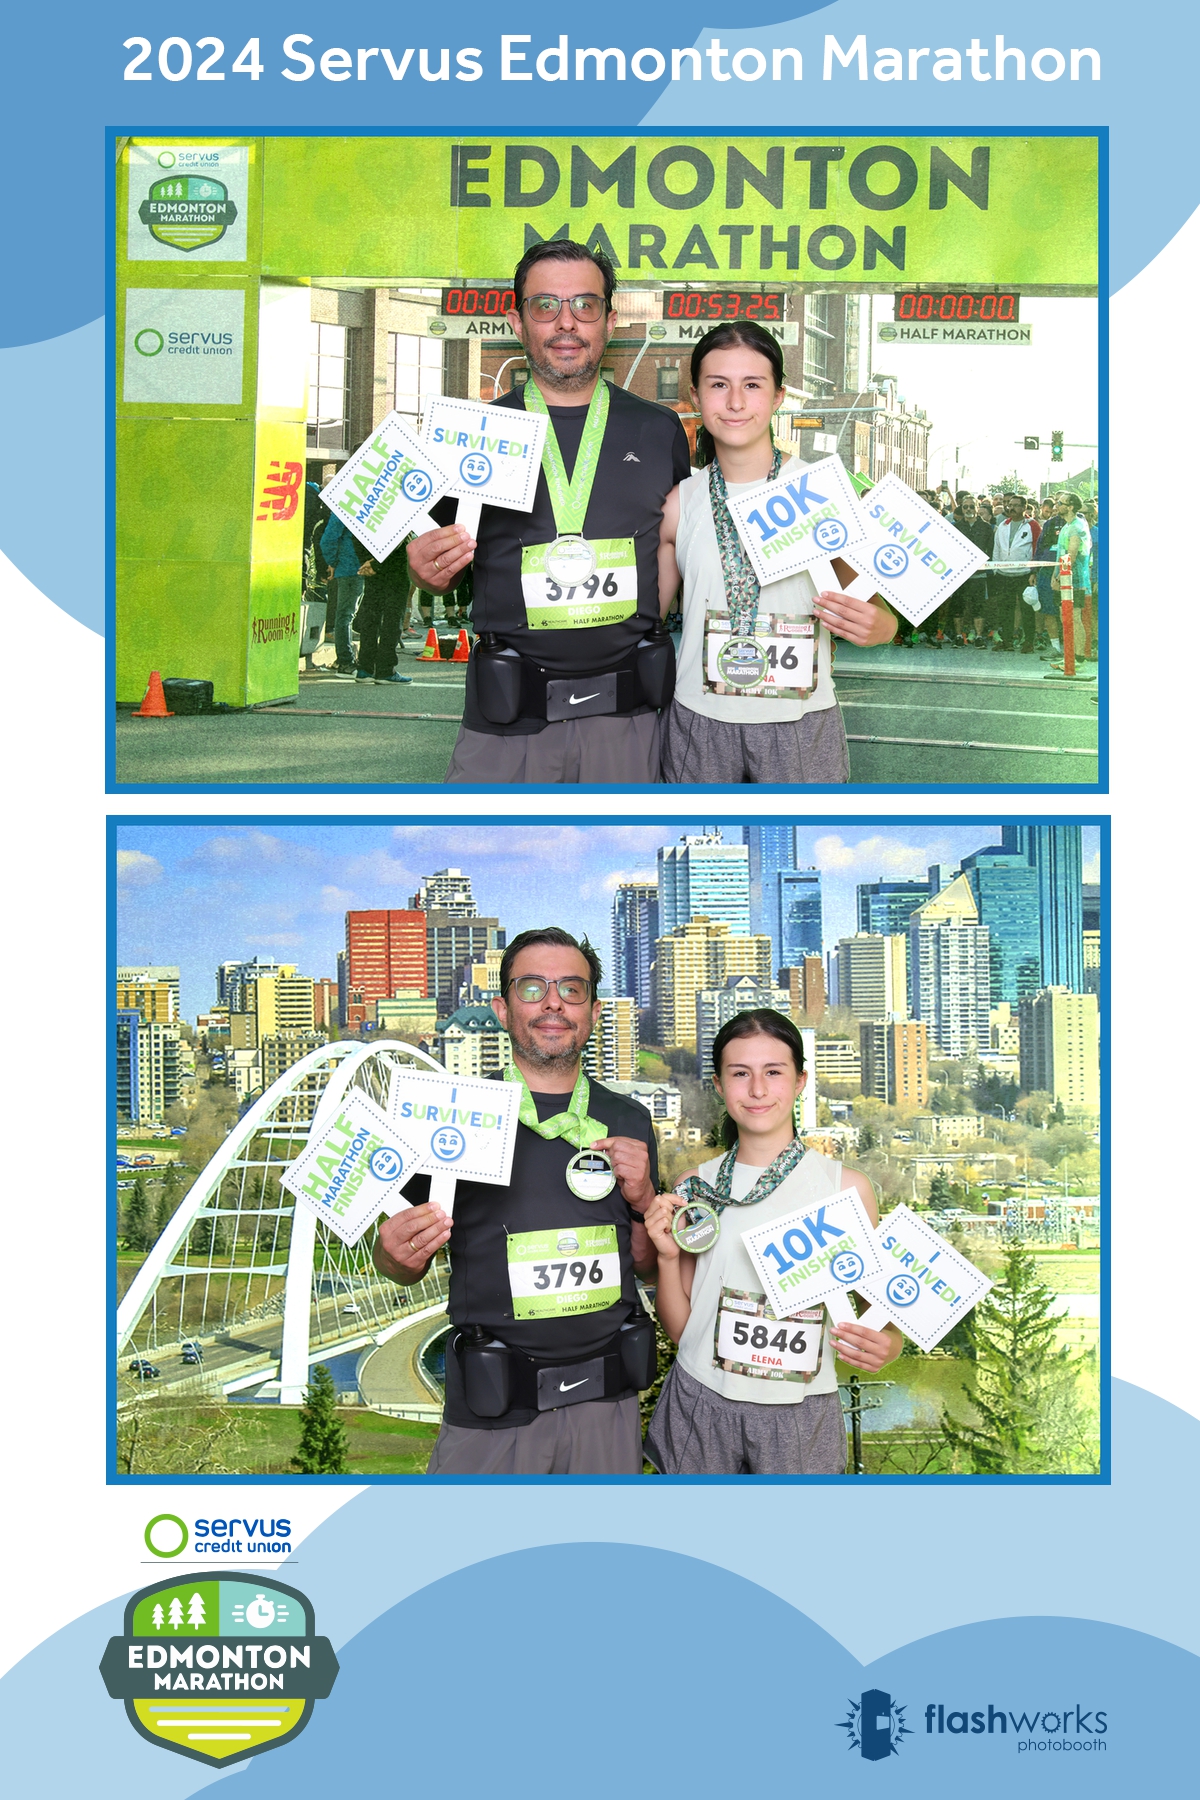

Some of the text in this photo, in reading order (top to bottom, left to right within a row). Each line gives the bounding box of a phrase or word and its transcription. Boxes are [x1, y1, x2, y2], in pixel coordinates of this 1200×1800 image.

[178, 152, 220, 161] servus
[450, 145, 991, 211] EDMONTON
[149, 203, 227, 214] EDMONTON
[160, 214, 216, 222] MARATHON
[168, 332, 233, 345] servus
[466, 321, 514, 335] ARMY
[900, 328, 1030, 341] HALF MARATHON
[168, 346, 200, 354] credit
[480, 416, 487, 431] I
[432, 427, 529, 459] SURVIVED!
[338, 436, 391, 517] HALF
[356, 450, 404, 525] MARATHON
[364, 456, 417, 534] FINISHER!
[746, 472, 829, 543] 10K
[761, 502, 841, 560] FINISHER!
[868, 504, 954, 580] SURVIVED!
[918, 521, 931, 534] I
[568, 606, 600, 617] DIEGO
[573, 617, 591, 625] HALF
[592, 614, 624, 623] MARATHON
[257, 613, 291, 644] Running
[451, 1088, 457, 1103] I
[400, 1102, 503, 1130] SURVIVED!
[301, 1112, 356, 1202] HALF
[320, 1127, 372, 1208] MARATHON
[332, 1134, 386, 1217] FINISHER!
[762, 1205, 846, 1276] 10K
[778, 1235, 858, 1292] FINISHER!
[882, 1236, 962, 1308] SURVIVED!
[928, 1251, 941, 1264] I
[533, 1260, 603, 1290] 3796
[556, 1293, 588, 1304] DIEGO
[579, 1301, 610, 1311] MARATHON
[733, 1321, 807, 1354] 5846
[751, 1354, 782, 1366] ELENA
